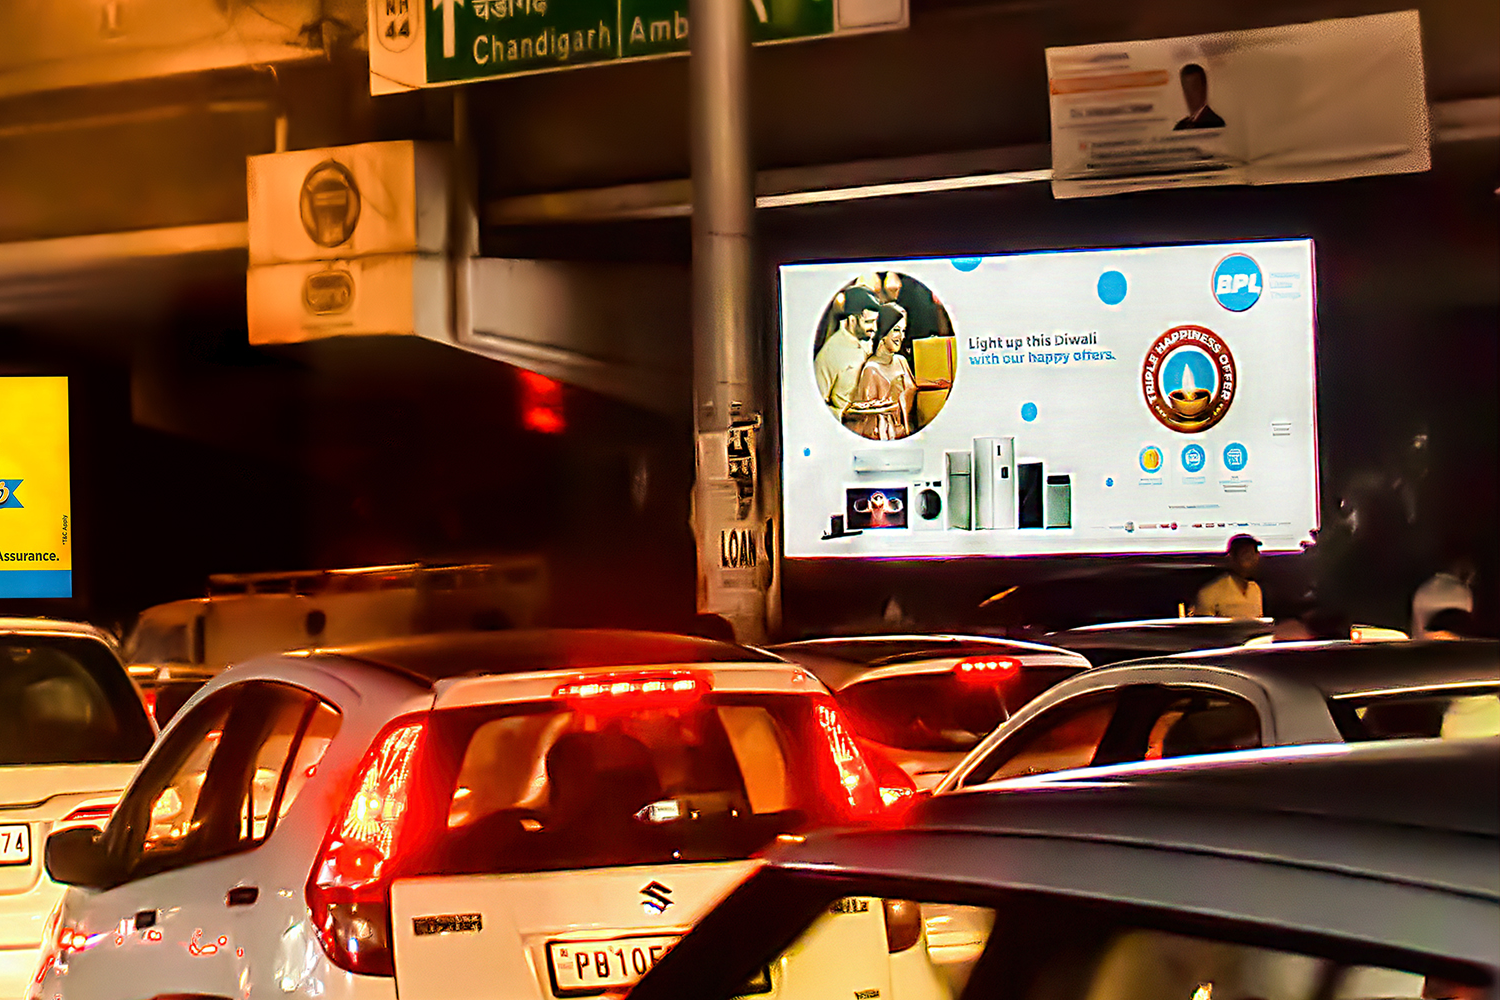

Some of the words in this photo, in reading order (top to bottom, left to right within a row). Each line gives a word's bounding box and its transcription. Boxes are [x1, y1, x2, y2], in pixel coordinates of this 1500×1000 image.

[630, 10, 689, 43] Amb
[473, 20, 611, 65] Chandigarh
[1215, 272, 1262, 295] BPL
[968, 337, 1003, 351] Light
[1006, 338, 1023, 351] up
[1026, 334, 1051, 347] this
[1054, 332, 1098, 346] Diwali
[969, 352, 1000, 365] with
[1002, 353, 1025, 365] our
[1028, 351, 1070, 365] happy
[1073, 349, 1117, 361] offers.
[1145, 353, 1159, 404] TRIPLE
[1155, 329, 1221, 354] HAPPINESS
[1219, 354, 1233, 400] OFFER
